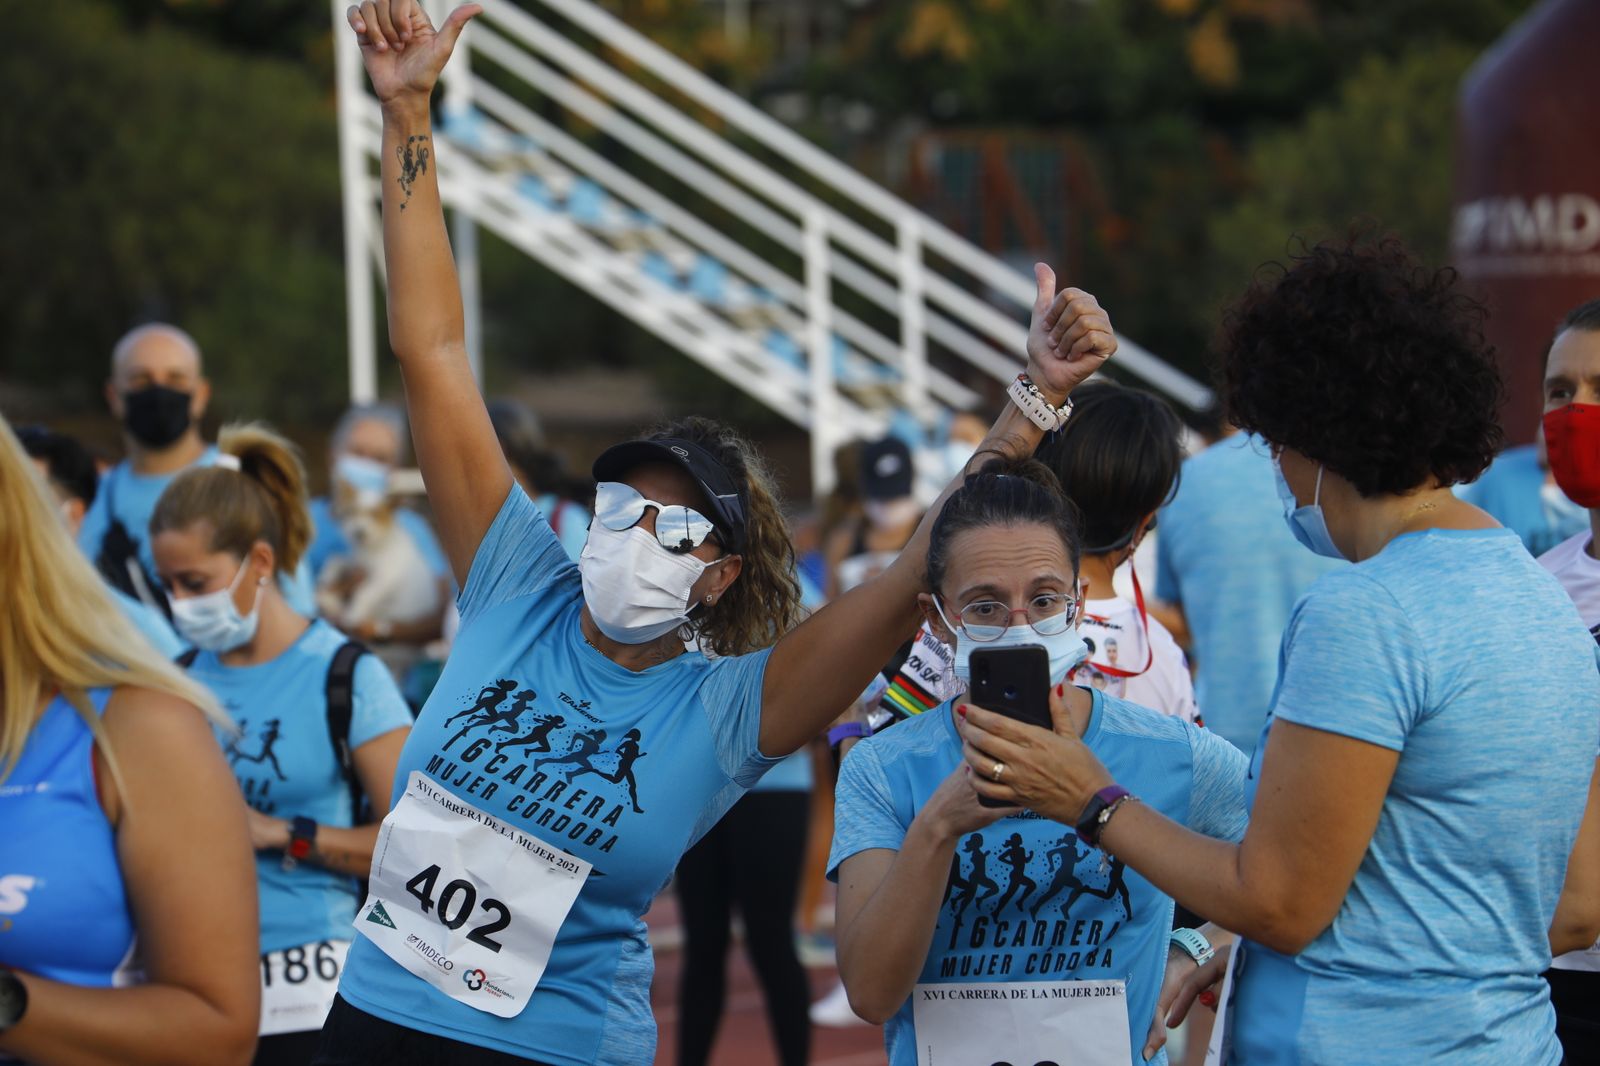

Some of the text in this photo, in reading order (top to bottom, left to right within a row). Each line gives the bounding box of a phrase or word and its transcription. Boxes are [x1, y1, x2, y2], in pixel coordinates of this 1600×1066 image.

[416, 779, 580, 874] XVI CARRERA DE LA MUJER 2021
[425, 754, 619, 853] MUJER CÓRDOBA
[405, 863, 512, 954] 402
[416, 940, 454, 970] IMDECO
[940, 954, 1013, 977] MUJER
[923, 986, 1116, 1000] XVI CARRERA DE LA MUJER 2021
